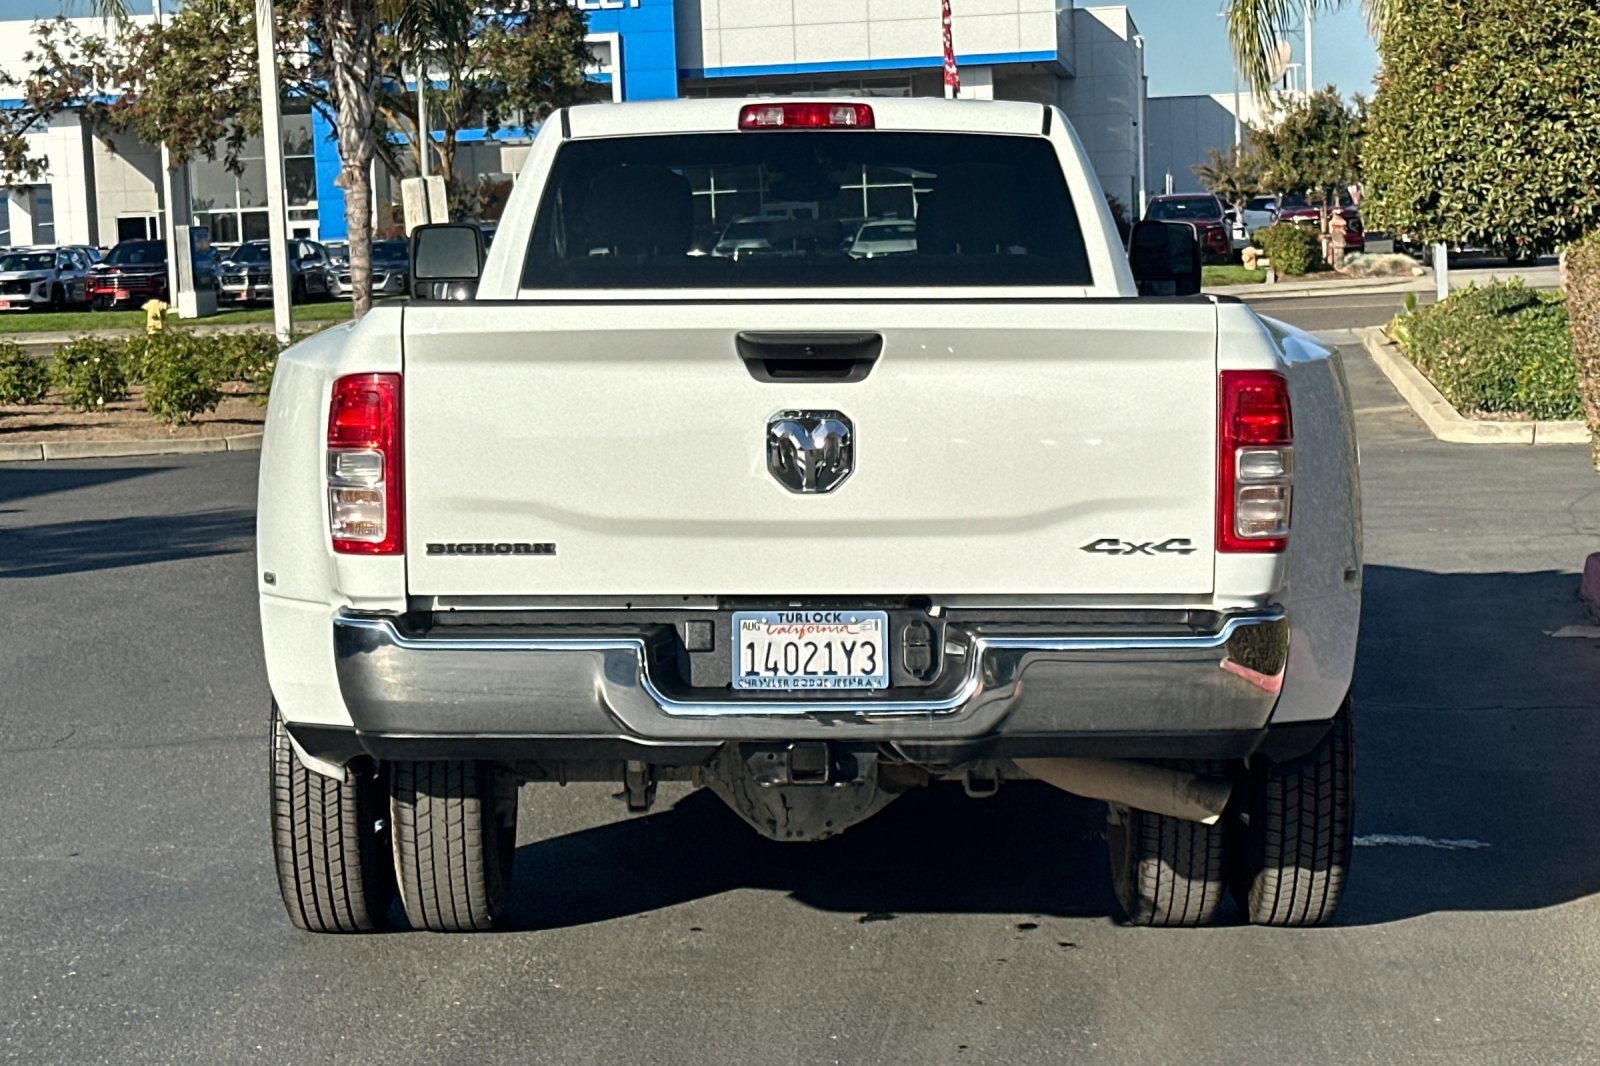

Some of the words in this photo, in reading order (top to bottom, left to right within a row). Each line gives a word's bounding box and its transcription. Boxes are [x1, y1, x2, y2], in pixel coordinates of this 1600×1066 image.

[426, 543, 557, 556] BIGHORN
[1079, 538, 1198, 556] 4x4
[777, 612, 842, 624] TURLOCK
[742, 621, 761, 632] AUG
[766, 623, 860, 640] California
[745, 640, 877, 677] 14021Y3
